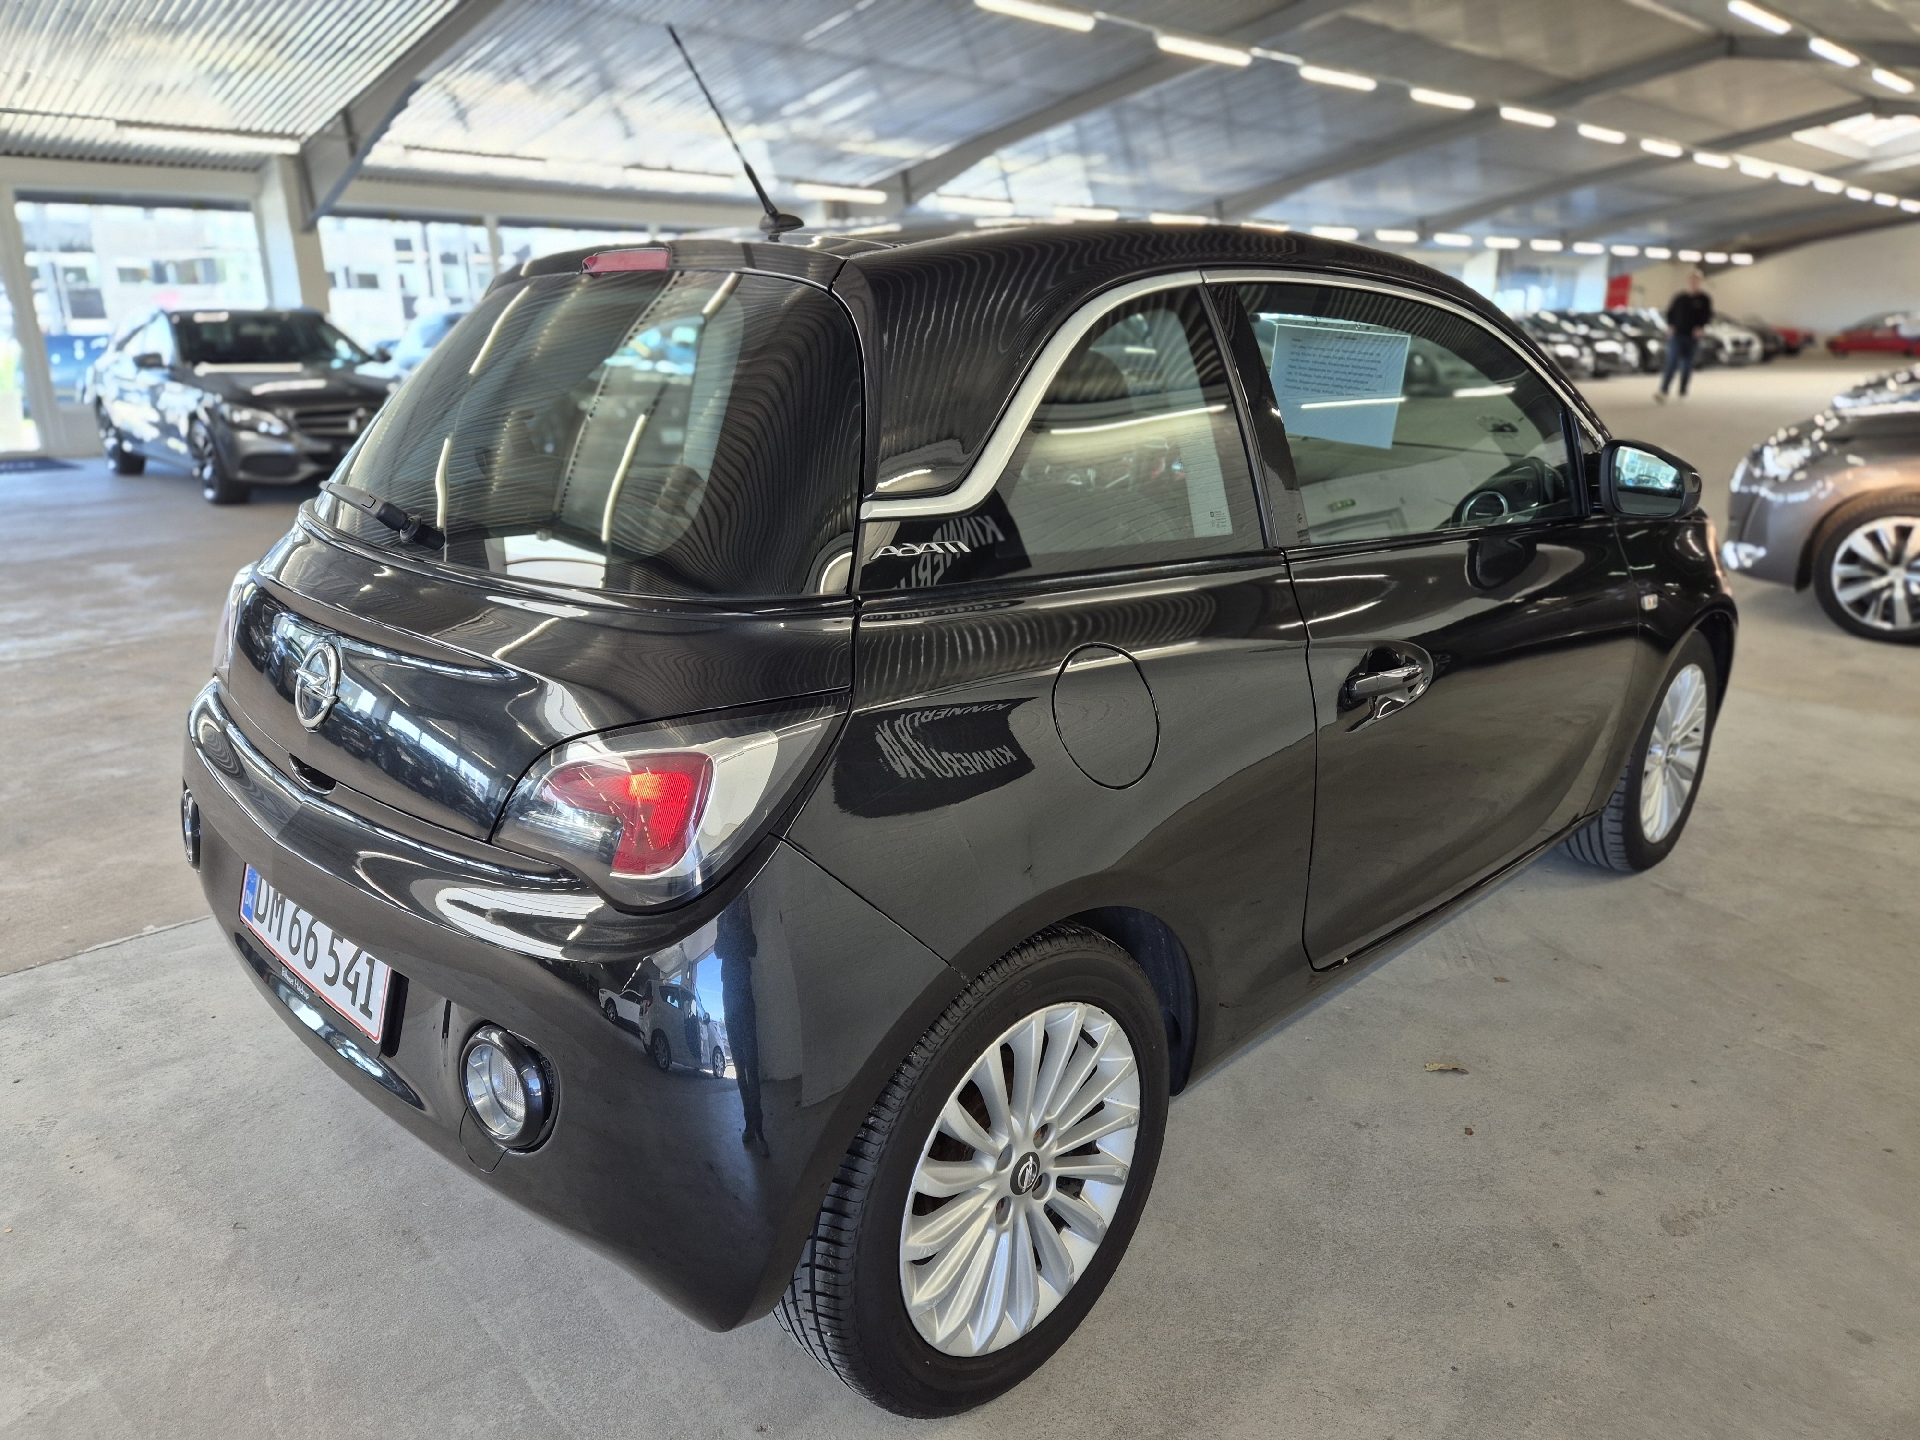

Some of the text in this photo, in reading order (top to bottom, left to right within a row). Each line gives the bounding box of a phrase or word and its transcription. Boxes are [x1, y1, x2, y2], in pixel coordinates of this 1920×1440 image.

[870, 540, 972, 561] ADAM
[253, 876, 376, 1021] DM 66 541
